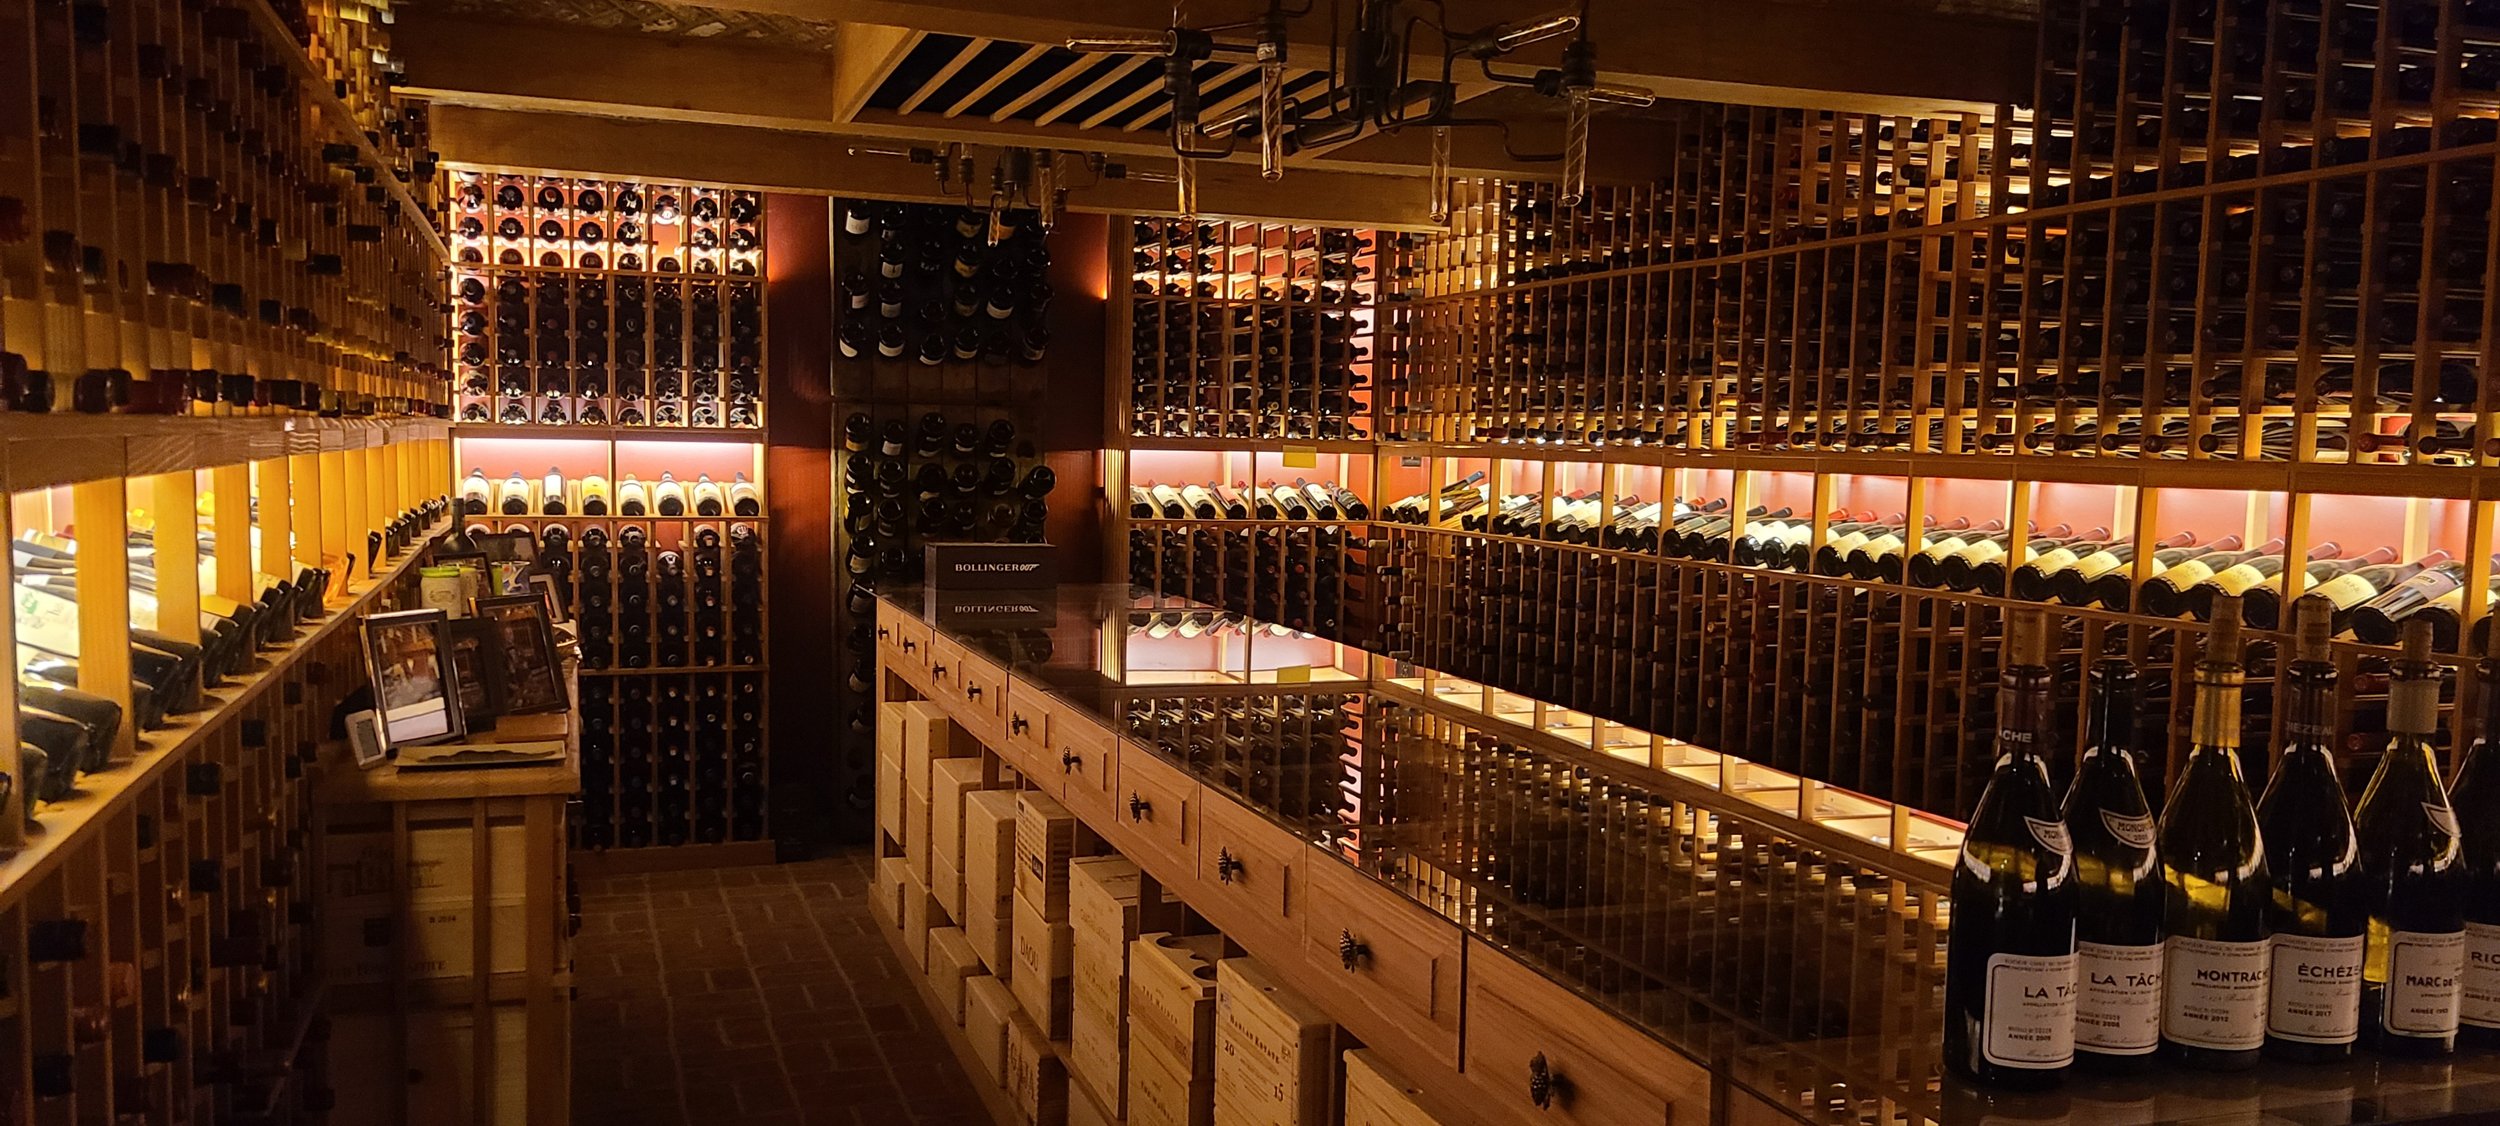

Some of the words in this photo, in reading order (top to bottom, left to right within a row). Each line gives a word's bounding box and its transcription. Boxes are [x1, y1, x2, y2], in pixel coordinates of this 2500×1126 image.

[2470, 950, 2500, 965] RIC
[2090, 971, 2118, 988] LA
[2405, 974, 2442, 988] MARC
[2024, 985, 2050, 1000] LA
[1223, 1039, 1235, 1057] 20
[1273, 1082, 1284, 1102] 15
